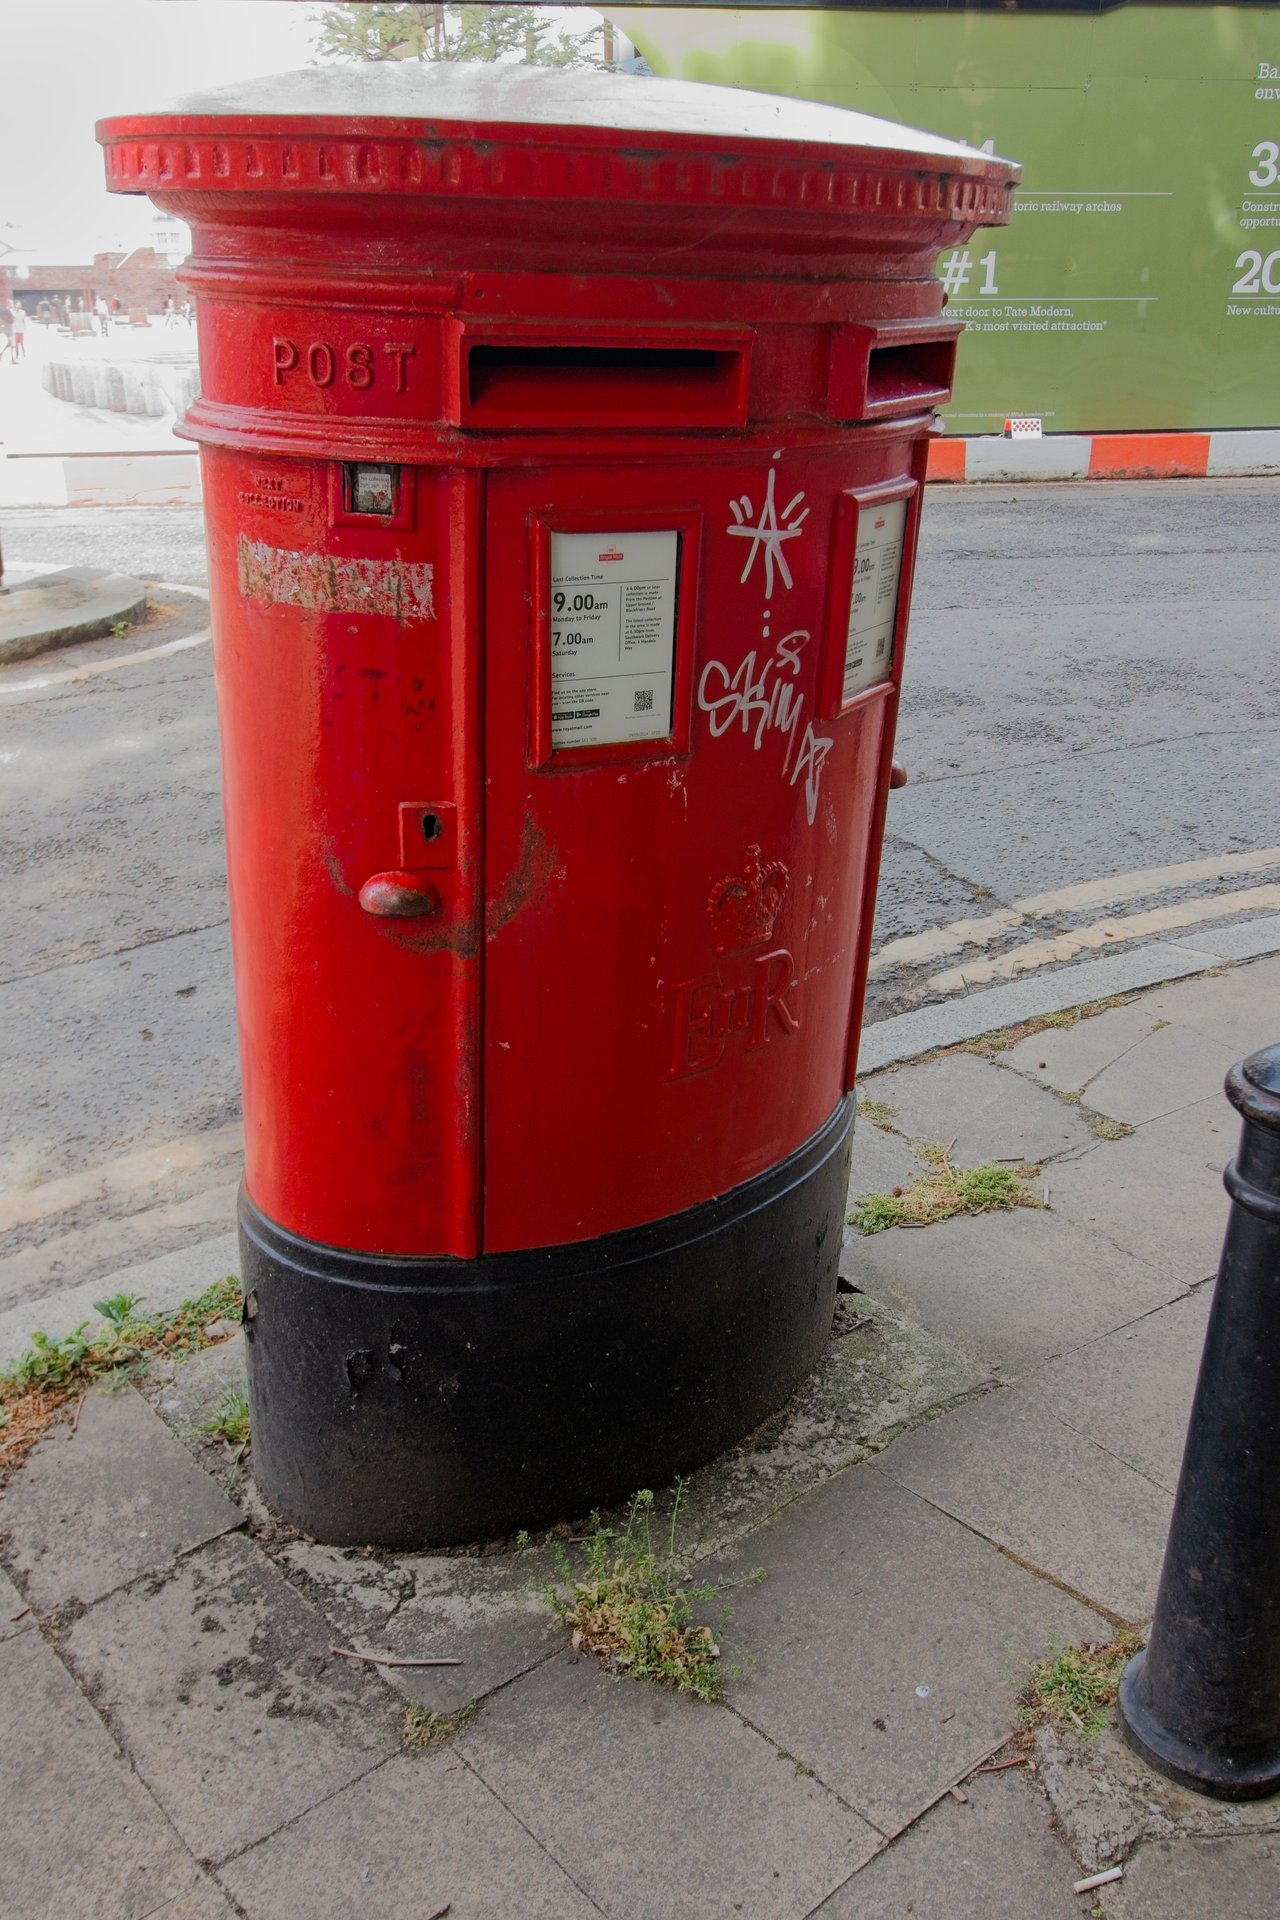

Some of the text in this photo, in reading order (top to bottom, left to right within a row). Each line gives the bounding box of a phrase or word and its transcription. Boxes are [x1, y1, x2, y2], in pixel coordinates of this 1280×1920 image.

[1258, 63, 1280, 78] Ba
[1249, 141, 1280, 187] 3
[1014, 201, 1122, 214] toric railway arches
[1242, 201, 1280, 211] Constr
[966, 306, 989, 317] door
[992, 307, 1002, 317] to
[1004, 306, 1028, 317] Tate
[1029, 306, 1074, 318] Modern,
[1226, 305, 1252, 315] New
[965, 321, 981, 331] K's
[983, 321, 1009, 331] most
[1011, 321, 1048, 331] visited
[273, 337, 416, 393] POST
[254, 475, 283, 491] NEXT
[239, 491, 303, 513] COLLECTION
[553, 592, 608, 612] 9.00am
[552, 632, 594, 646] 7.00am
